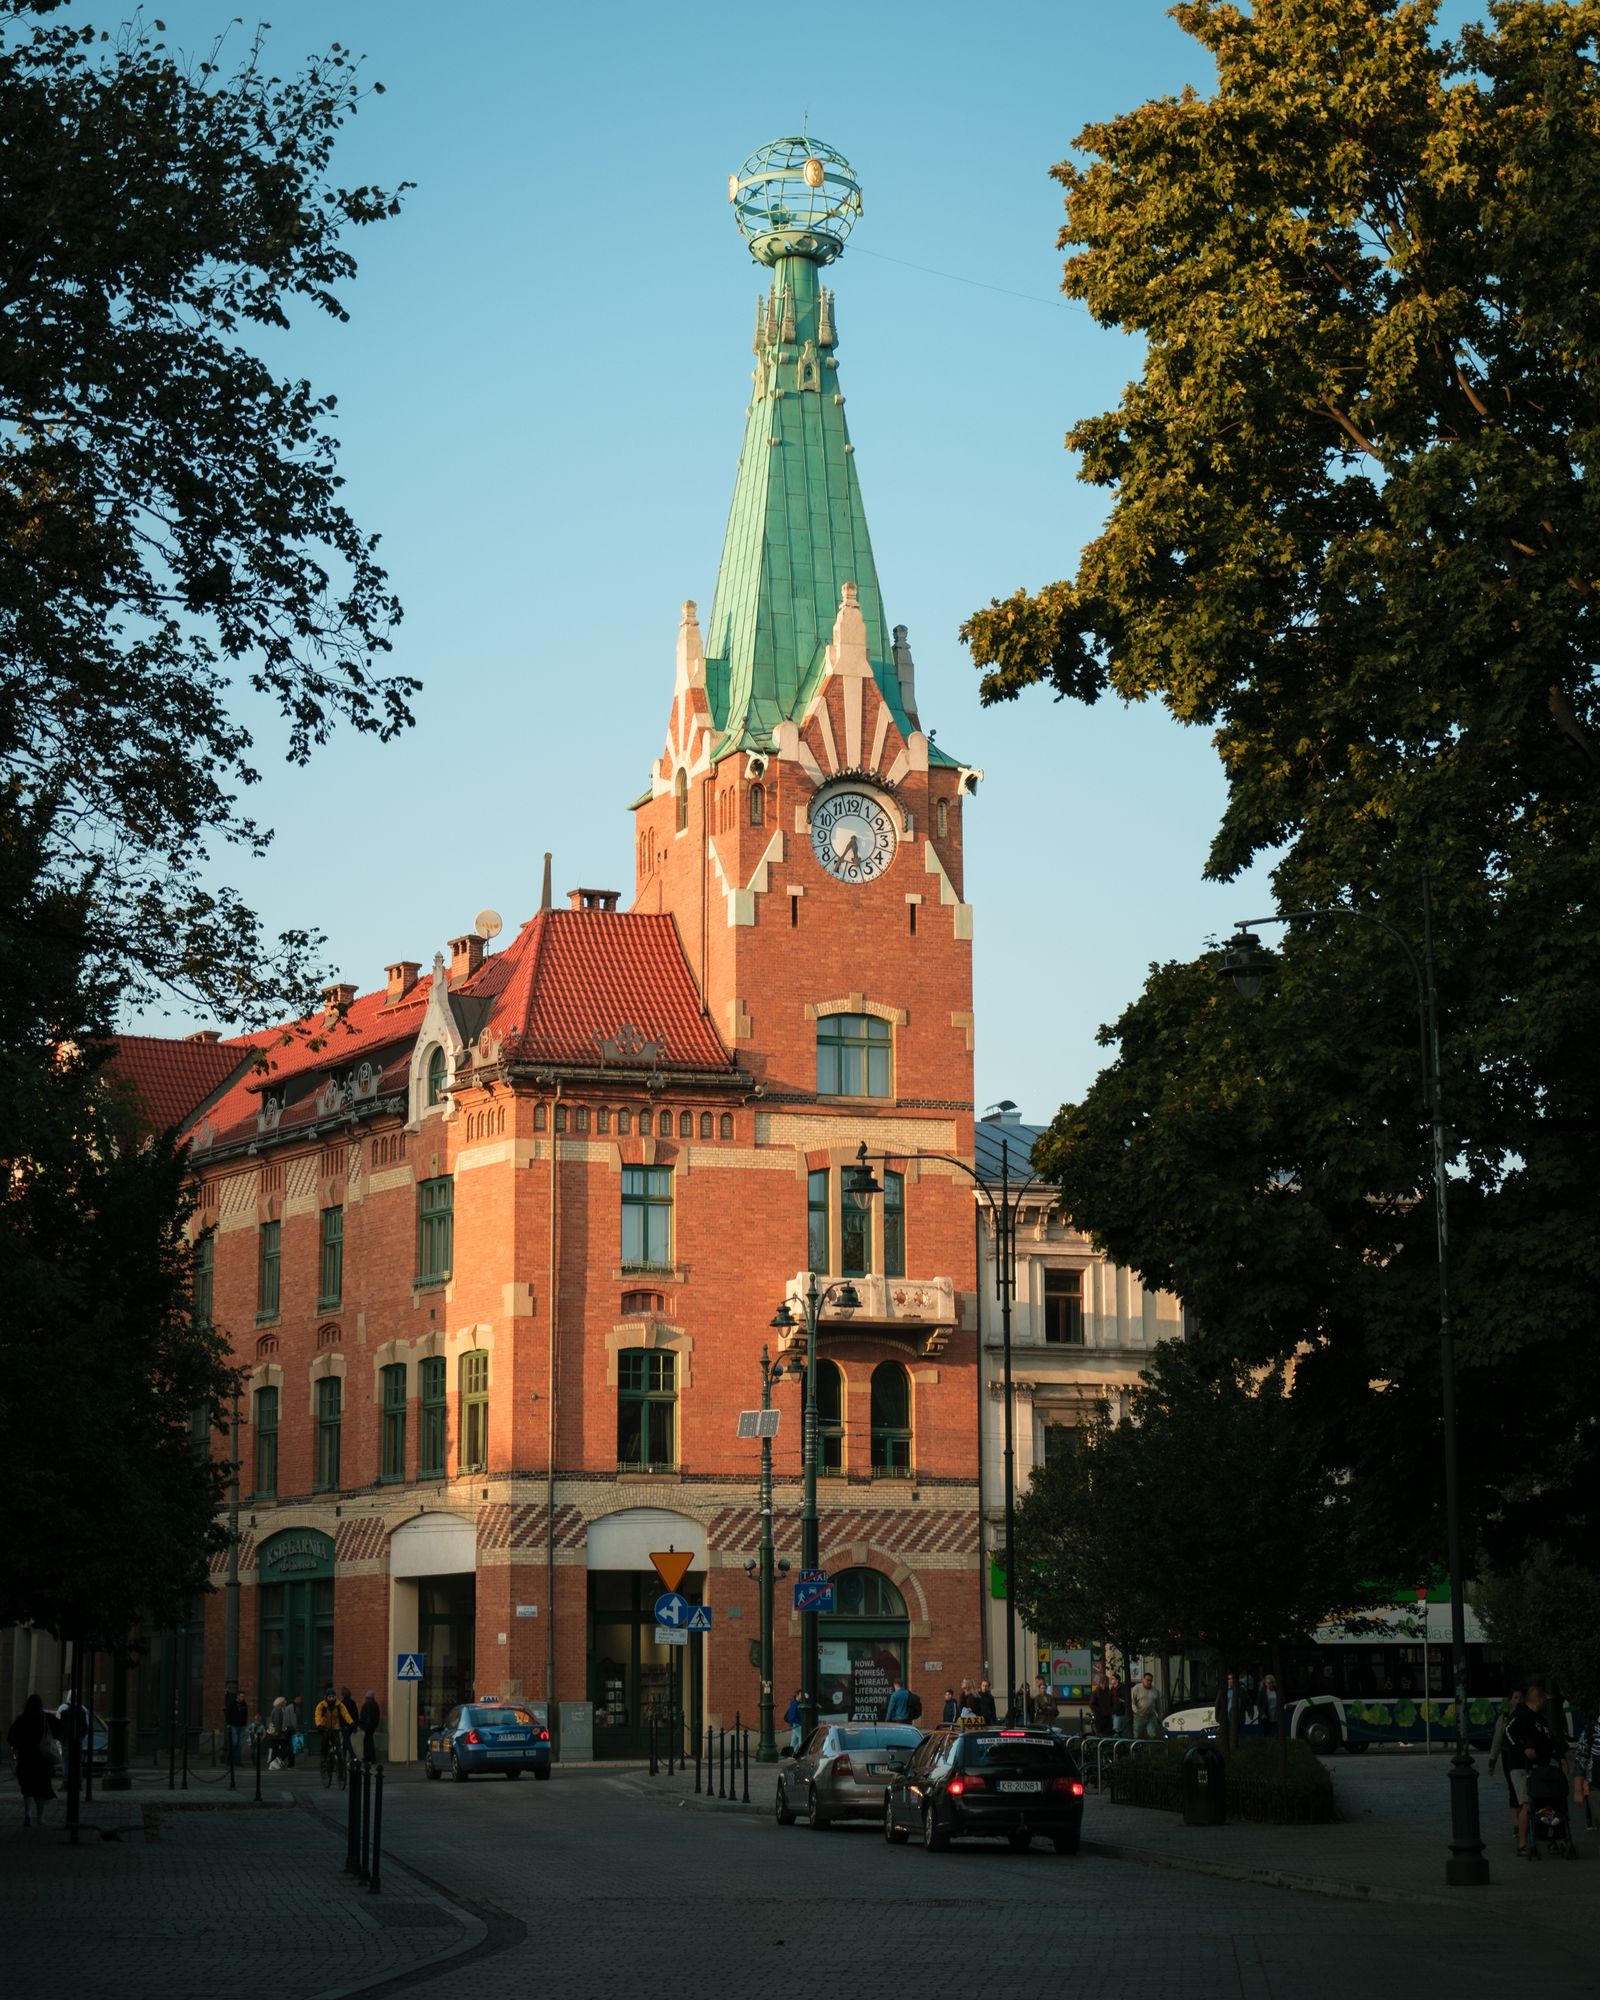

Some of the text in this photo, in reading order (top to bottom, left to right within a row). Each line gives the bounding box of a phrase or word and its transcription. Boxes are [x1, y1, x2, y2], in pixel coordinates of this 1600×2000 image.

[833, 801, 843, 815] 11
[846, 799, 860, 813] 12
[820, 813, 832, 827] 10
[875, 817, 885, 831] 2
[818, 830, 828, 844] 9
[880, 834, 889, 848] 3
[822, 847, 831, 862] 8
[873, 850, 884, 865] 4
[847, 865, 857, 878] 6
[863, 861, 873, 874] 5
[801, 1570, 826, 1581] TAXI
[855, 1668, 886, 1677] POWIEŚĆ
[855, 1678, 889, 1686] LAUREATA
[855, 1696, 887, 1704] NAGRODY
[855, 1705, 878, 1713] NOBLA
